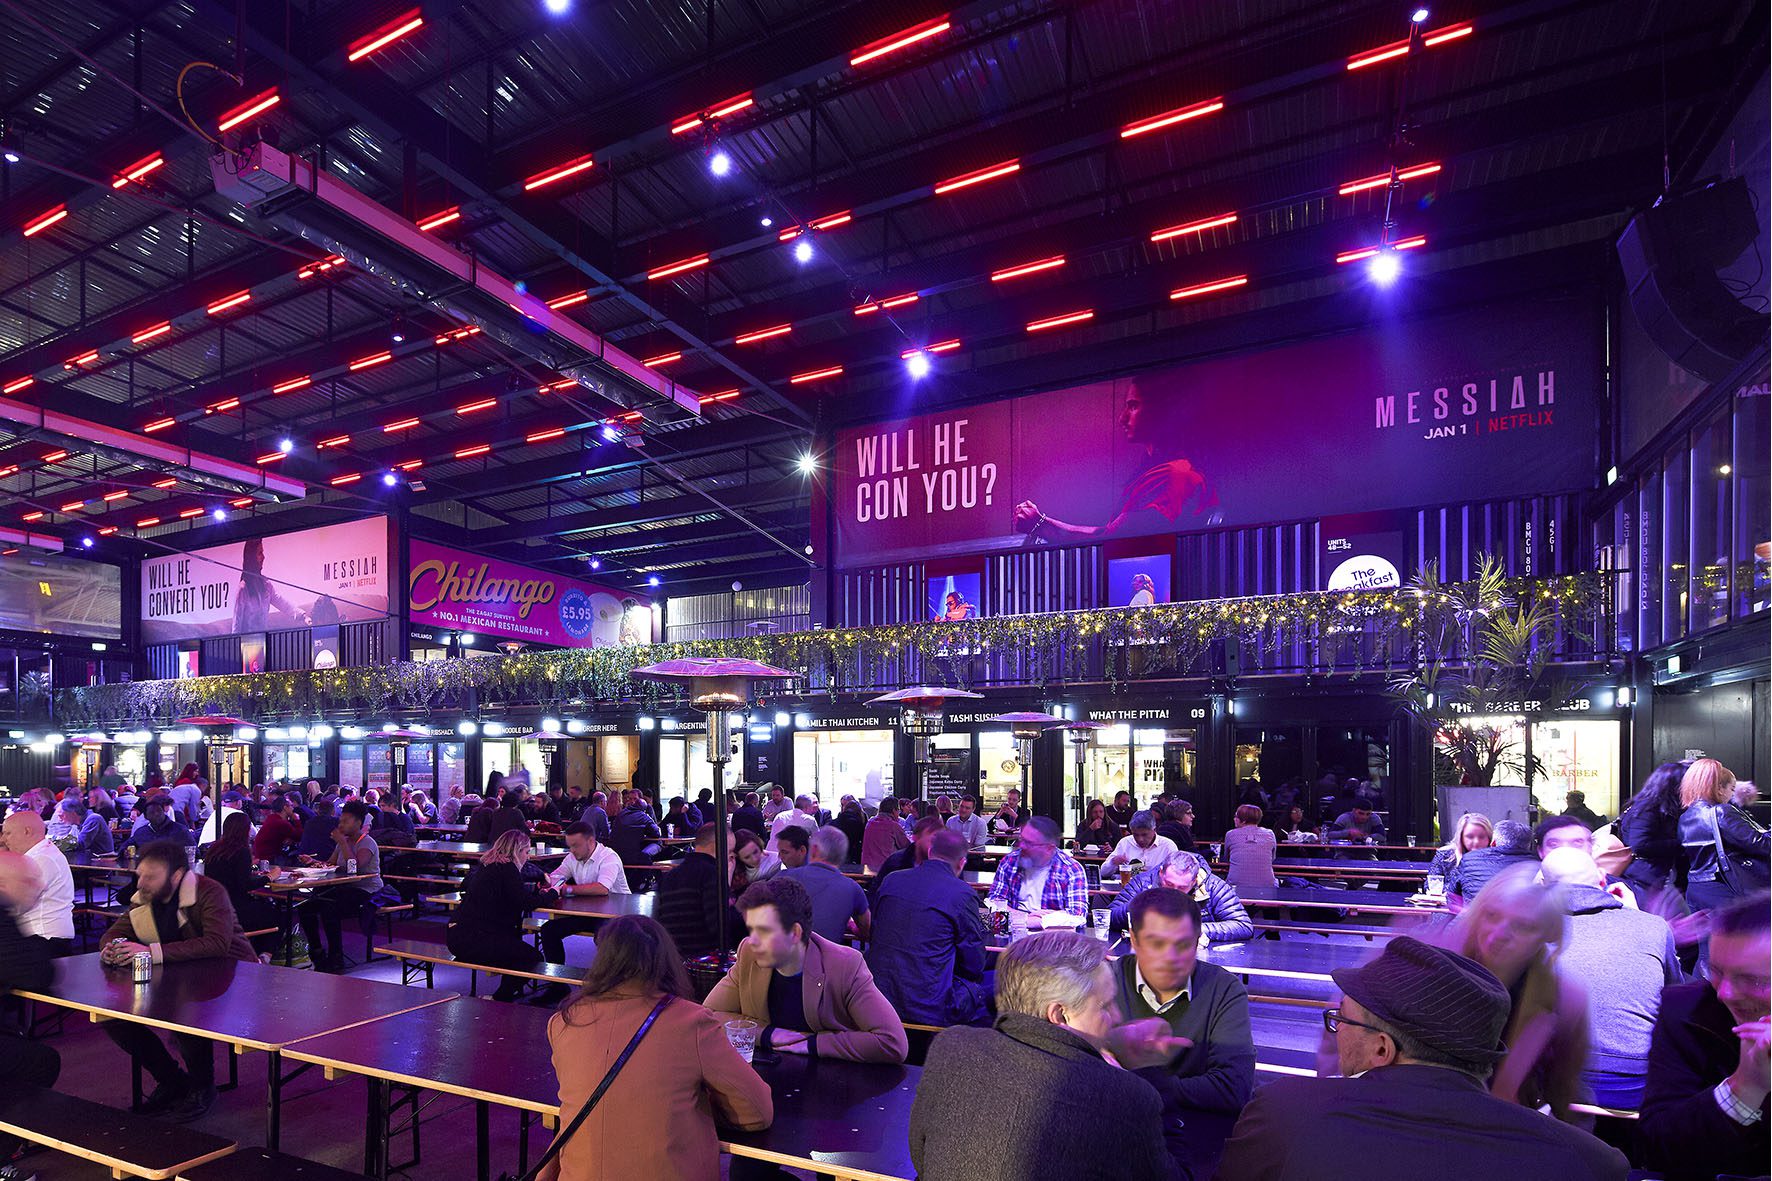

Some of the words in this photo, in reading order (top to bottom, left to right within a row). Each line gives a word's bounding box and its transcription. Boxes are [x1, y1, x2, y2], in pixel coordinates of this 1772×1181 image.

[1375, 371, 1554, 428] MESSIAH
[1424, 425, 1455, 440] JAN
[1460, 424, 1467, 434] 1
[1488, 411, 1553, 433] NETFLIX
[856, 429, 920, 478] WILL
[935, 419, 968, 466] HE
[856, 476, 908, 523] CON
[922, 463, 997, 514] YOU?
[1327, 538, 1347, 546] UNITS
[149, 563, 173, 590] WILL
[178, 559, 191, 586] HE
[323, 556, 377, 581] MESSIAH
[1350, 568, 1376, 581] The
[357, 577, 377, 588] NETFLIX
[1333, 571, 1394, 590] akfast
[410, 559, 556, 620] Chilango
[149, 587, 196, 617] CONVERT
[200, 581, 229, 611] YOU?
[476, 609, 493, 617] ZAGAT
[562, 606, 591, 621] £5.95
[440, 611, 459, 622] NO.1
[460, 614, 496, 629] MEXICAN
[498, 621, 543, 636] RESTAURANT
[949, 713, 973, 723] TASHI
[1089, 710, 1116, 720] WHAT
[1118, 710, 1137, 719] THE
[1140, 709, 1169, 719] PITTA!
[1190, 708, 1205, 718] 09
[522, 726, 534, 734] BAR
[582, 725, 601, 733] ORDER
[602, 724, 618, 732] HERE
[802, 718, 827, 728] AMILE
[828, 718, 846, 727] THAI
[846, 717, 879, 727] KITCHEN
[888, 717, 898, 726] 11
[1552, 769, 1599, 777] BARBER
